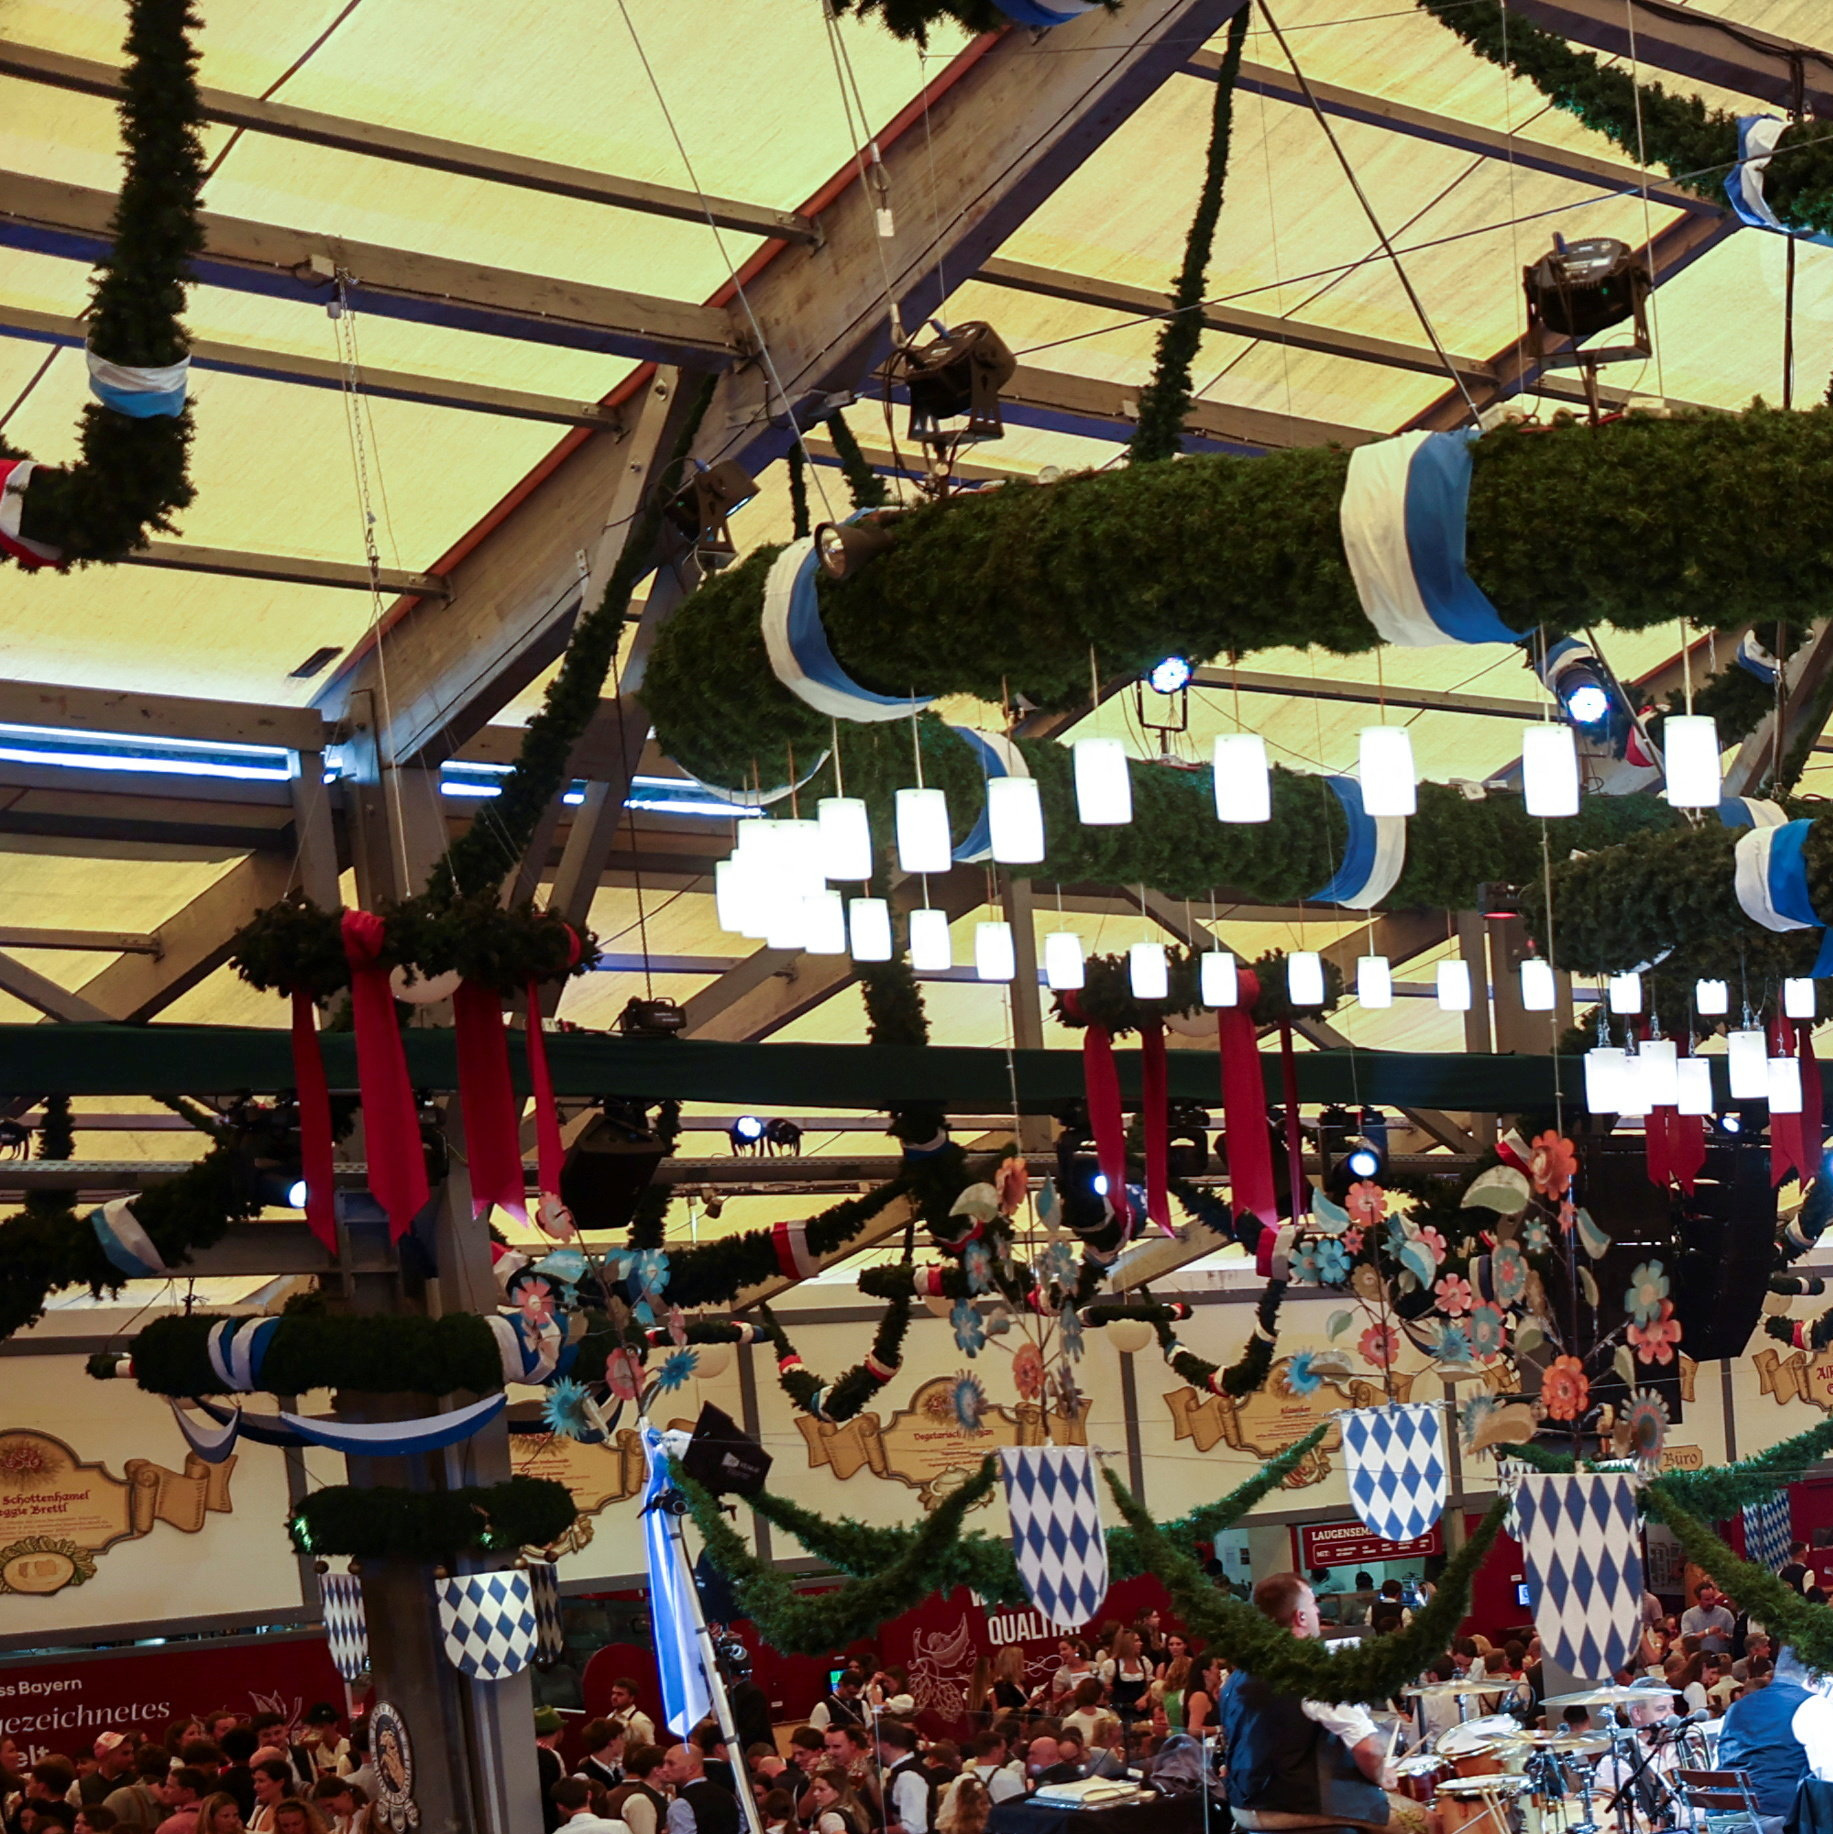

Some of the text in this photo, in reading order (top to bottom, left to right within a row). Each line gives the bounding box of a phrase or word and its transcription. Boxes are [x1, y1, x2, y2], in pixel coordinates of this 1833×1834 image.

[1663, 1451, 1698, 1467] Büro
[2, 1490, 91, 1505] Schottenhamel
[30, 1503, 69, 1515] Brettl
[1312, 1526, 1373, 1541] LAUGENSEM
[18, 1679, 82, 1696] Bayern
